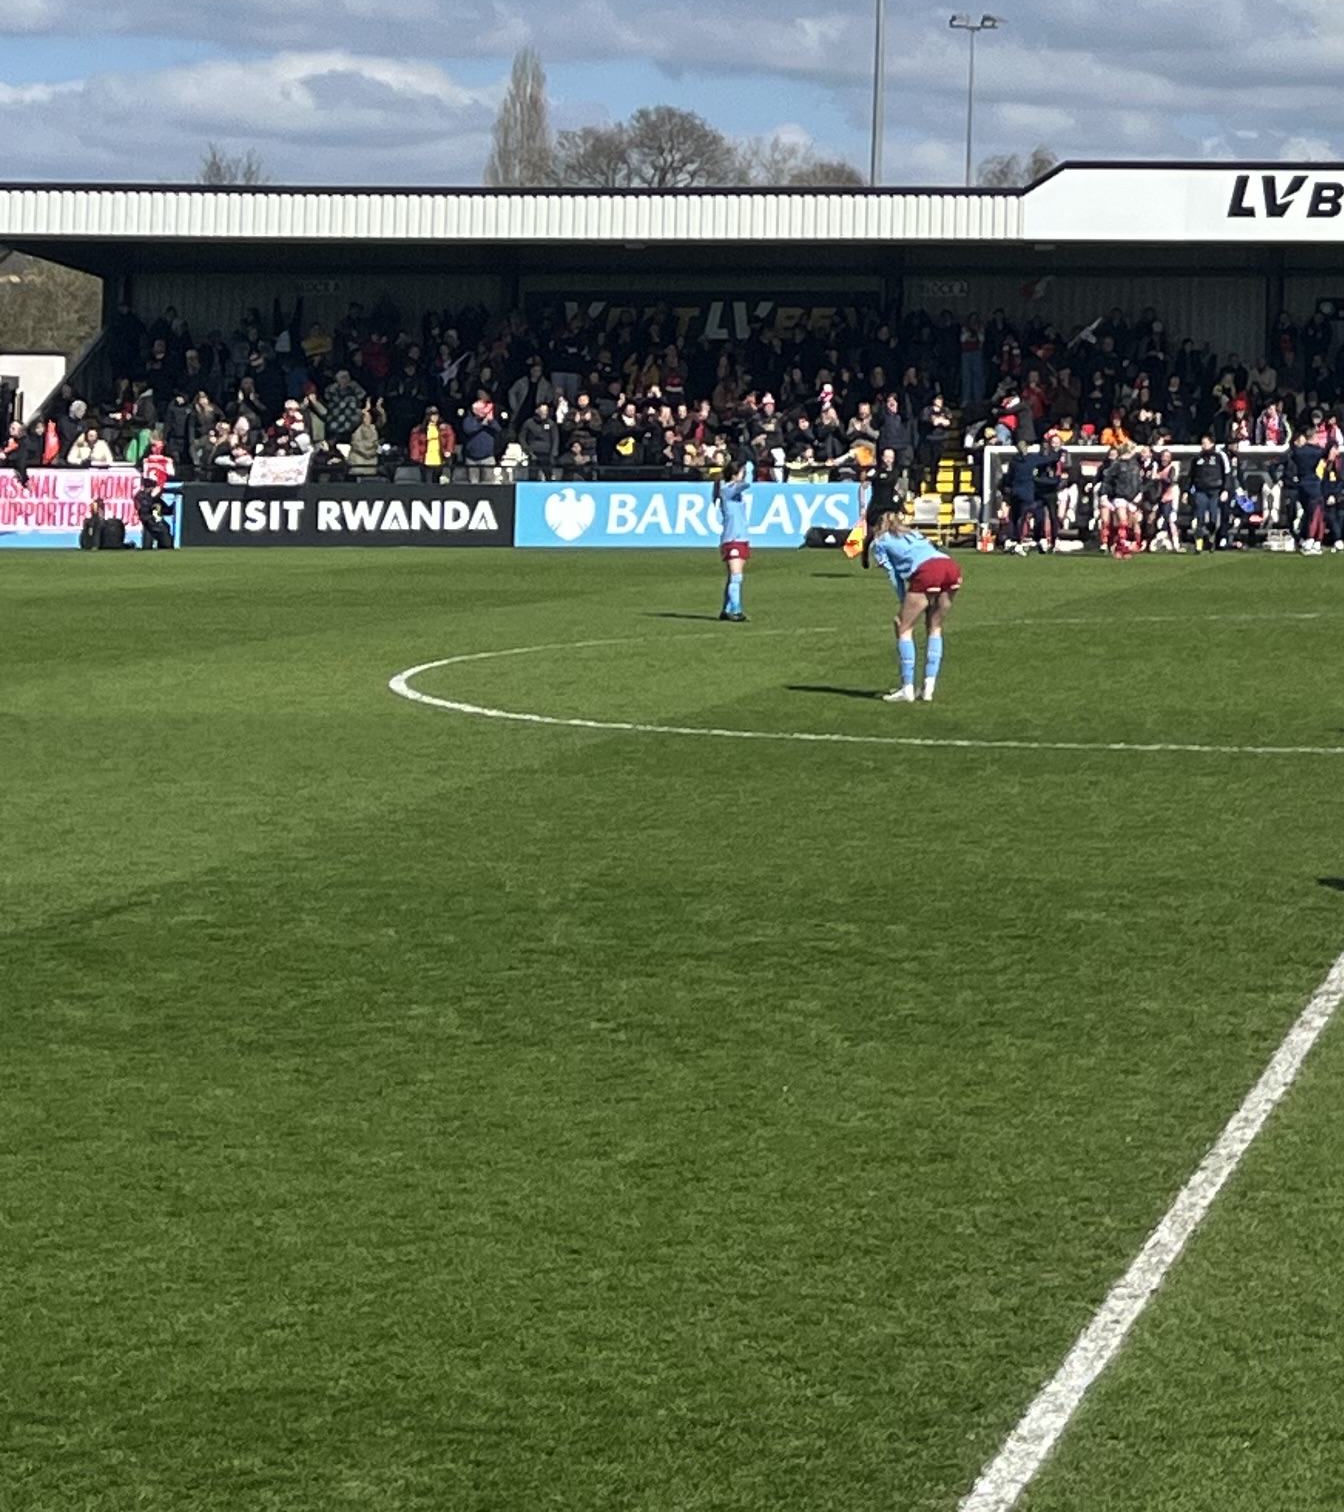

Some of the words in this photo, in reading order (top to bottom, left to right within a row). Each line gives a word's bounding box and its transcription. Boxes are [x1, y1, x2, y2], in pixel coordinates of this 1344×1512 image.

[91, 475, 140, 500] WOME
[199, 500, 304, 531] VISIT
[317, 500, 498, 531] RWANDA
